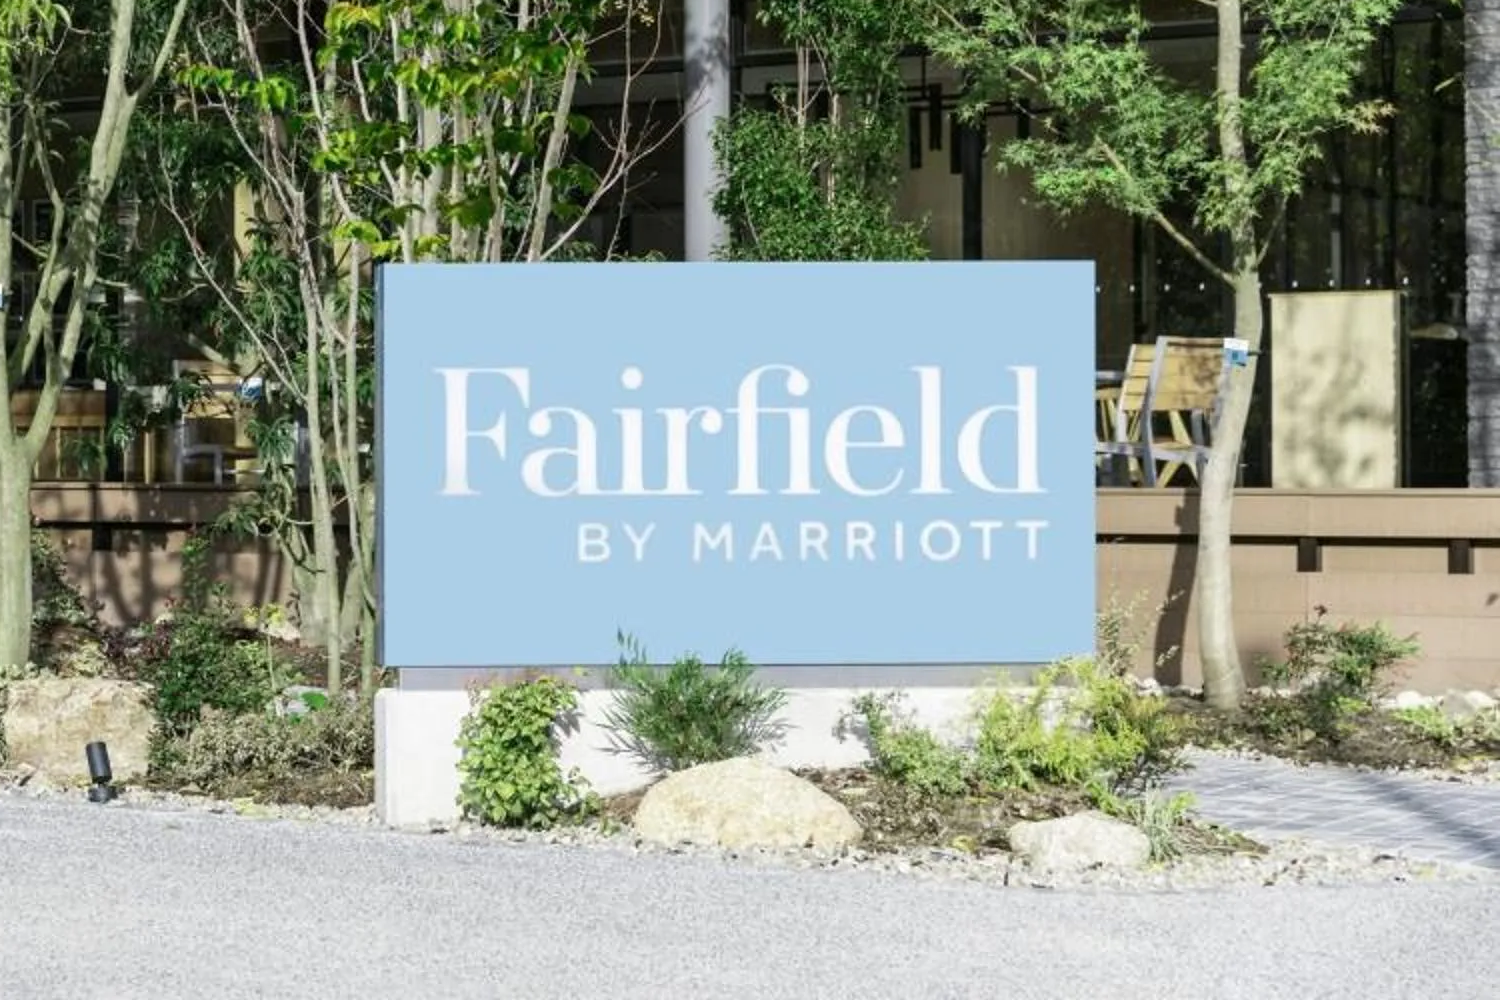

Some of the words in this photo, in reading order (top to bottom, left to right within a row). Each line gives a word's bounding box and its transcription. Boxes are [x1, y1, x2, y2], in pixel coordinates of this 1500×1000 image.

[432, 364, 1049, 498] Fairfield
[577, 521, 656, 563] BY
[692, 519, 1050, 562] MARRIOTT
